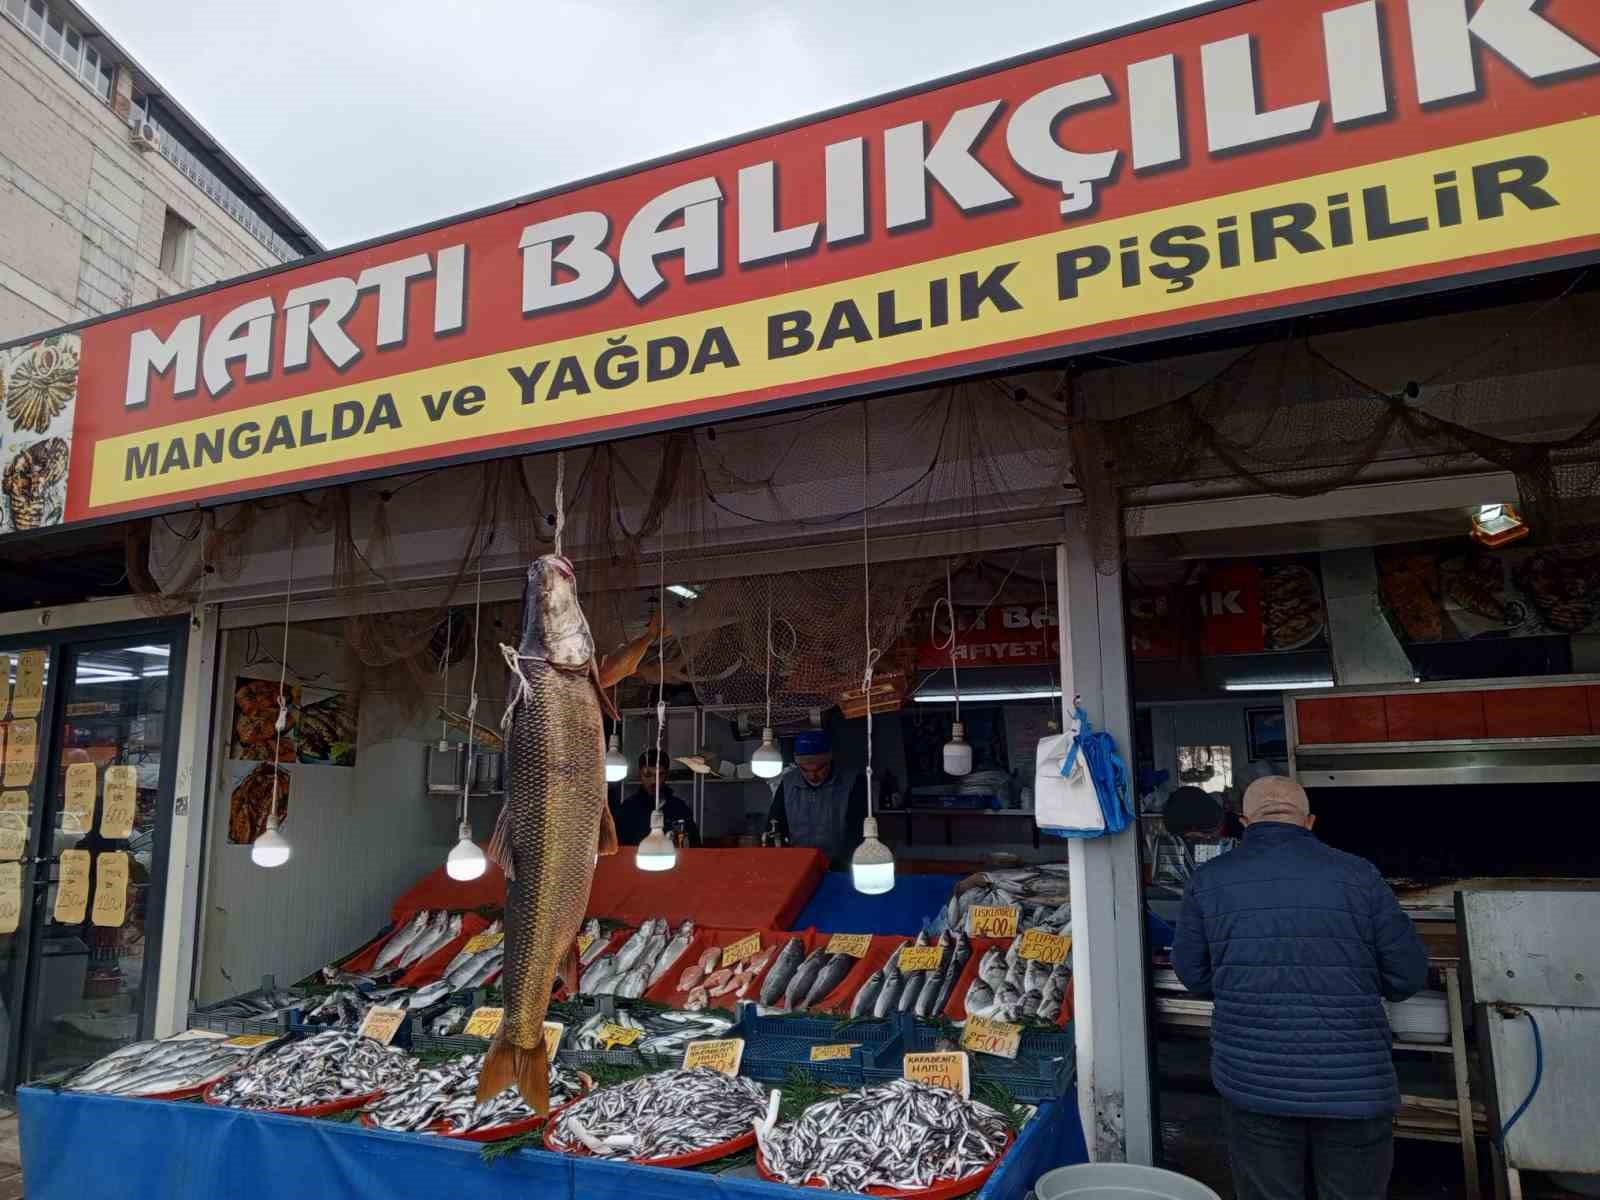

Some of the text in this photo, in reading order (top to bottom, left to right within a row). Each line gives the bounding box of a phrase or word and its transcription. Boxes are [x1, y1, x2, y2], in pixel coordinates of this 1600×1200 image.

[124, 0, 1600, 412] MARTI BALIKÇILIK
[122, 393, 403, 481] MANGALDA
[420, 384, 486, 422] ve
[507, 325, 741, 406] YAĞDA
[766, 261, 1024, 361] BALIK
